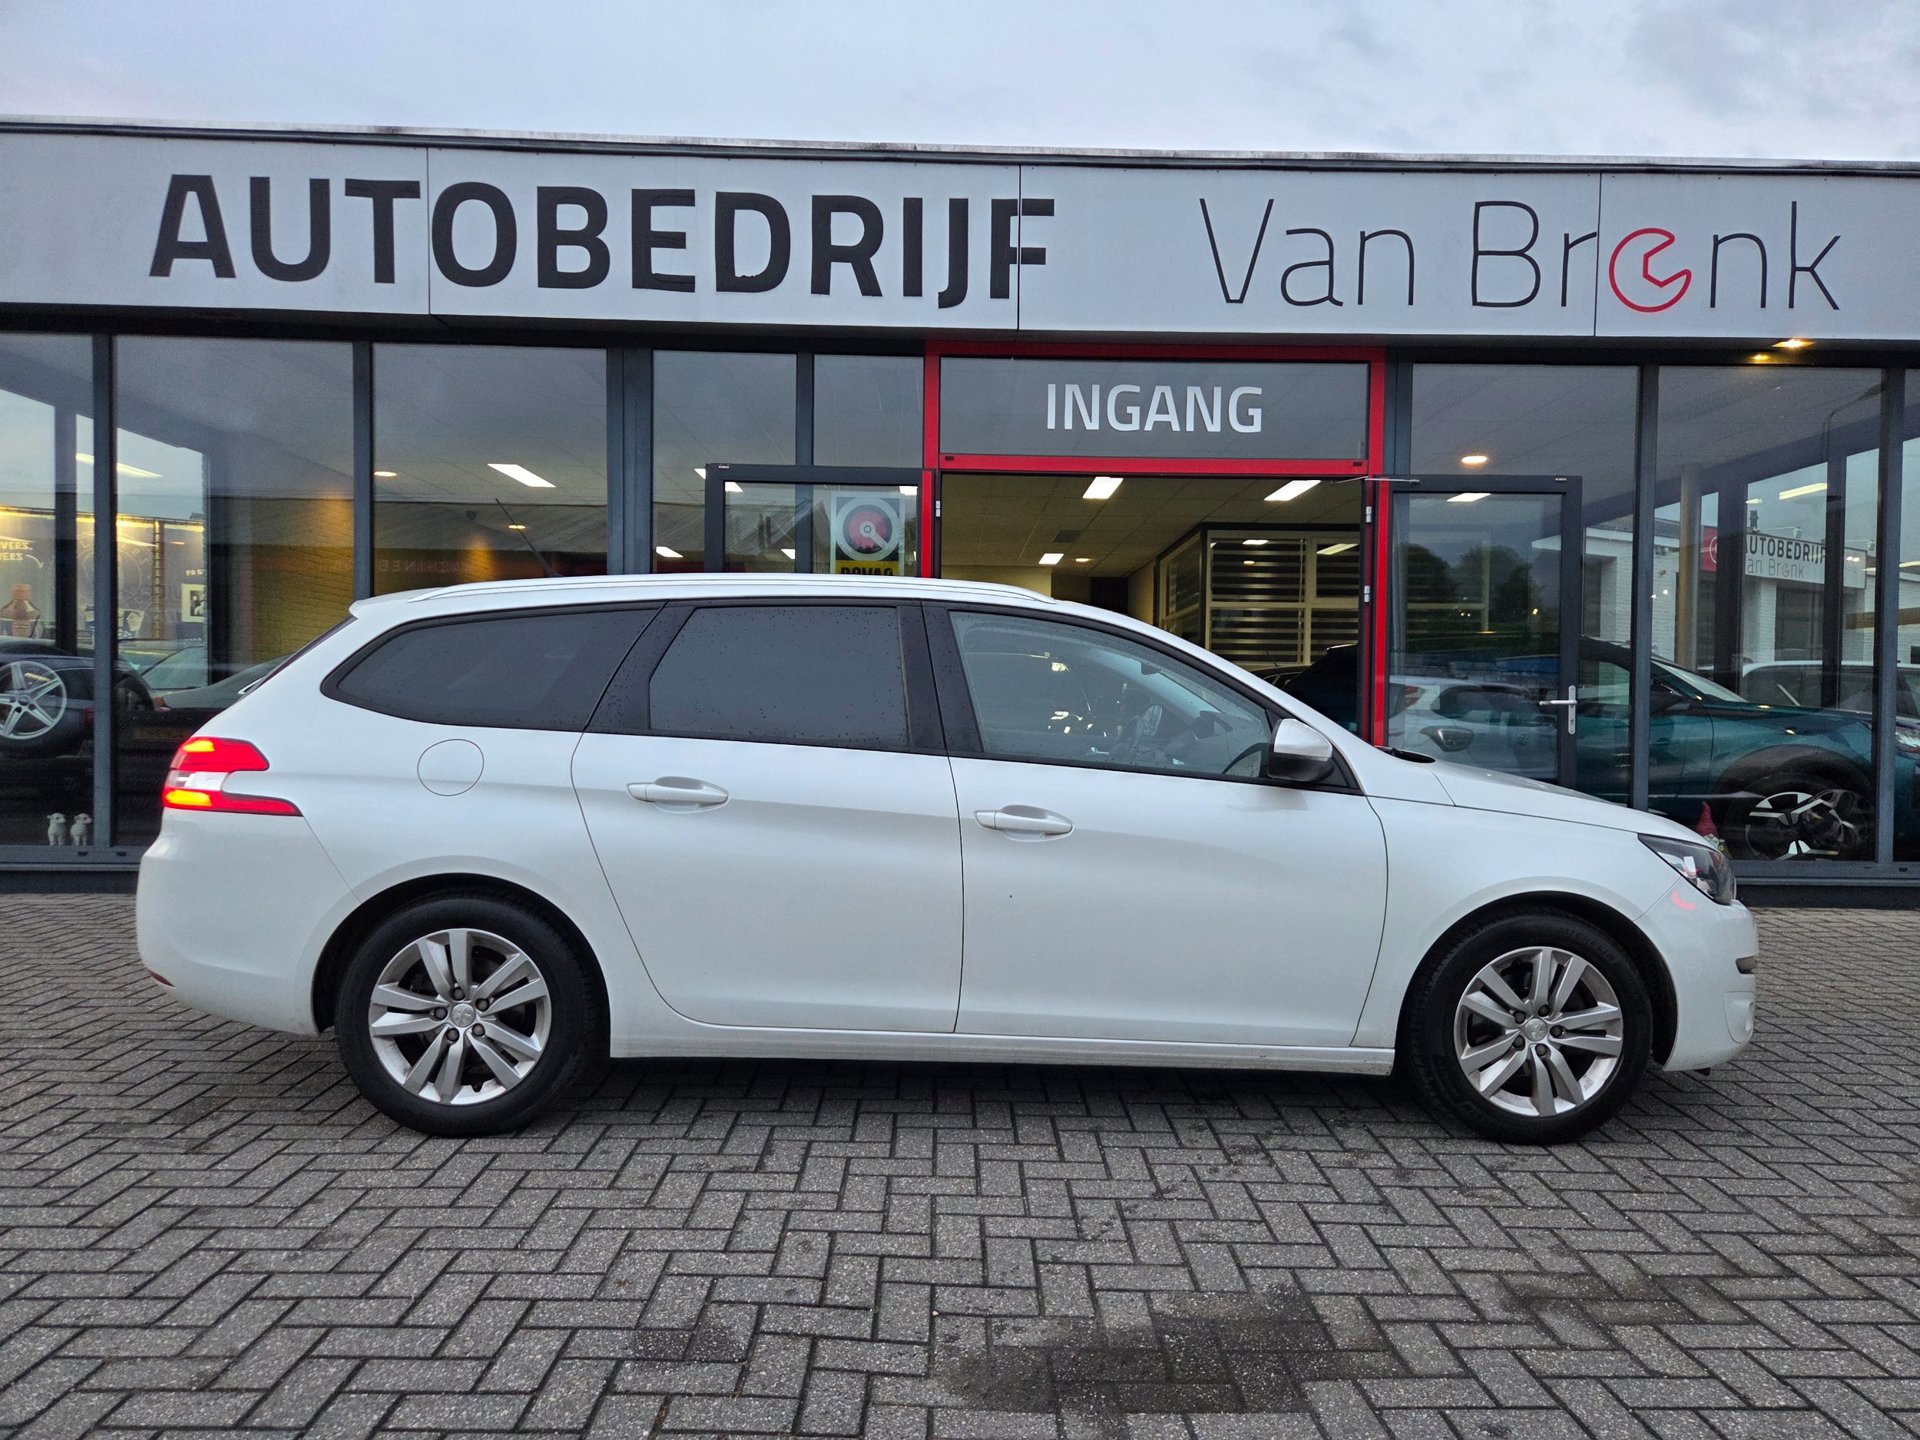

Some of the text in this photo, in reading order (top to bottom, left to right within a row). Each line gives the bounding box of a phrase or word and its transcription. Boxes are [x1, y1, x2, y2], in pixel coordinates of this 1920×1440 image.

[149, 174, 1055, 309] AUTOBEDRIJF
[1200, 198, 1415, 308] Van
[1047, 383, 1262, 433] INGANG
[1745, 535, 1826, 564] UTOBEDRIJF
